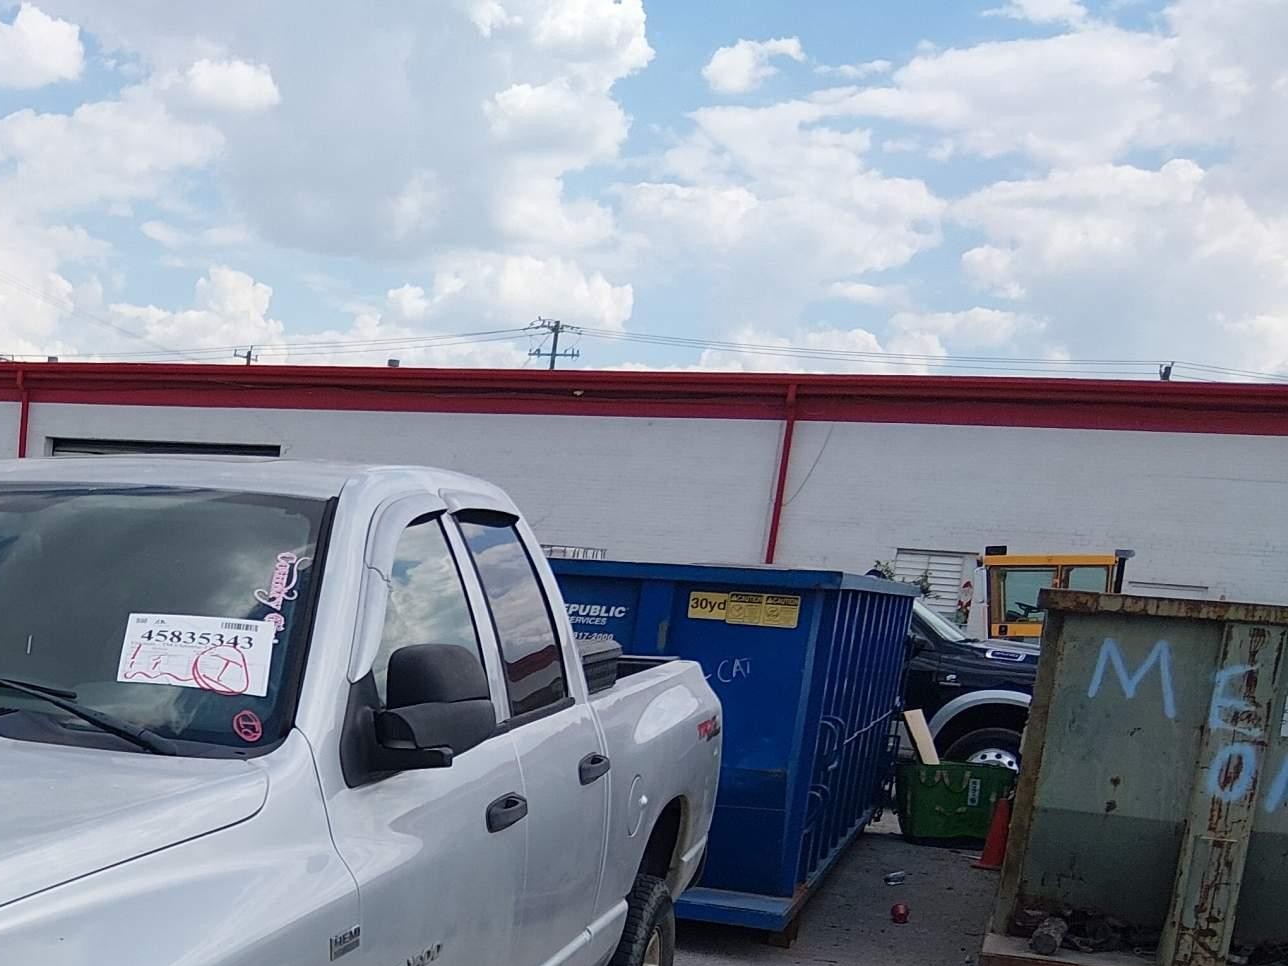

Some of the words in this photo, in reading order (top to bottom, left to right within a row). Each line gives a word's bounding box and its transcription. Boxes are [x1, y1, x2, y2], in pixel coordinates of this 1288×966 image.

[690, 598, 727, 613] 30yd
[568, 616, 607, 625] ERVICES
[141, 629, 254, 650] 45835343
[717, 657, 751, 683] CAT
